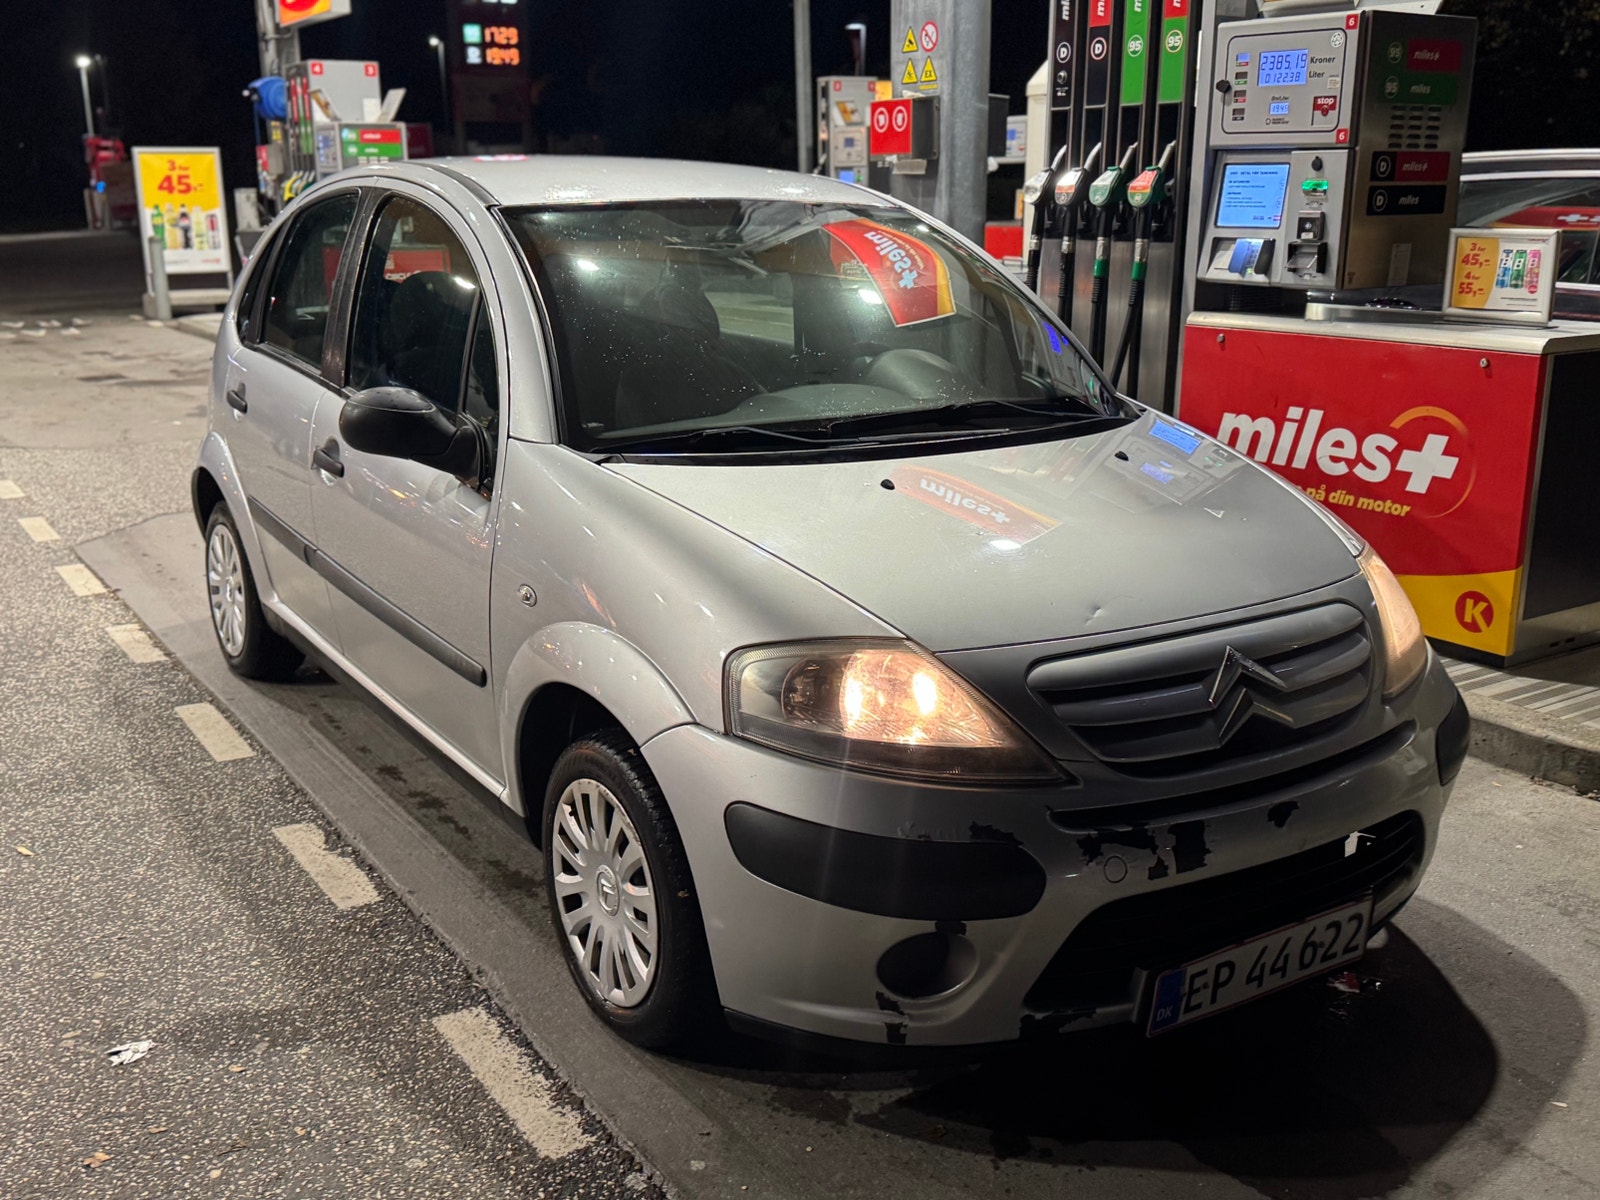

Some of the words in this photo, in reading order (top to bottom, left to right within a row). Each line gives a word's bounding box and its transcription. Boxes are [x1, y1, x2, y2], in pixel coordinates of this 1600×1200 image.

[1061, 0, 1070, 21] mi
[1129, 40, 1142, 52] 95
[1167, 35, 1181, 48] 95
[1060, 47, 1068, 59] D
[1095, 43, 1103, 55] D
[1389, 47, 1402, 59] 95
[1309, 56, 1336, 65] Kroner
[924, 70, 932, 79] EX
[1308, 70, 1325, 79] Liter
[1385, 82, 1398, 93] 95
[1410, 83, 1431, 94] miles
[1316, 96, 1335, 106] stop
[167, 160, 176, 171] 3
[1398, 194, 1420, 206] miles
[1470, 242, 1478, 252] 3
[1464, 271, 1471, 280] 4
[1216, 406, 1459, 494] miles+
[1328, 489, 1355, 507] din
[1356, 496, 1411, 516] motor
[1183, 960, 1236, 1015] EP
[1246, 937, 1293, 989] 44
[1299, 912, 1364, 972] 622
[1156, 1004, 1173, 1022] DK
